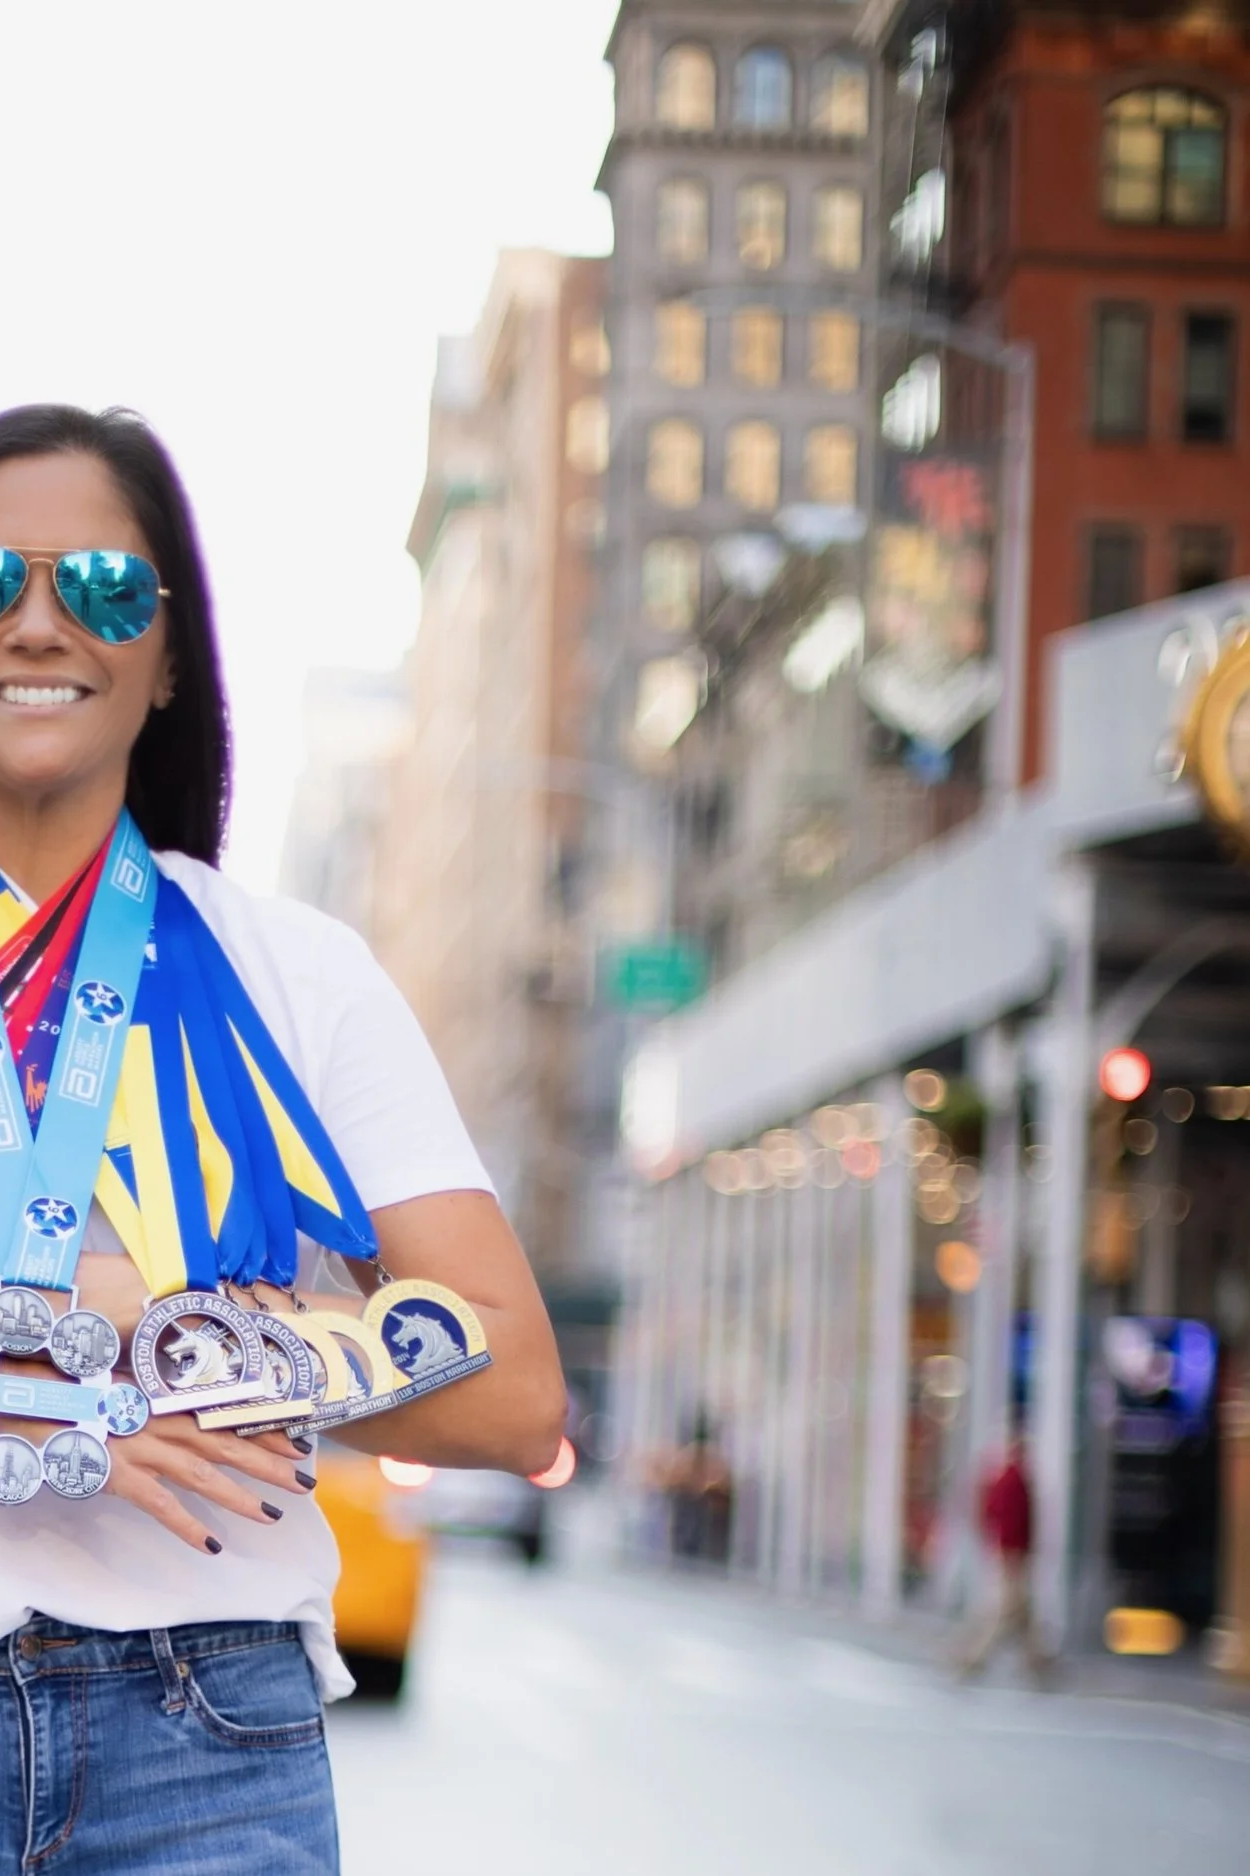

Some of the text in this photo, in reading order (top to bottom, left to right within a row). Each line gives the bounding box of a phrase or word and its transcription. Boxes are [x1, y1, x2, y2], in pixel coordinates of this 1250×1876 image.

[138, 1297, 262, 1391] BOSTON ATHLETIC ASSOCIATION
[255, 1316, 312, 1392] ASSOCIATION
[393, 1353, 410, 1365] 2014
[415, 1373, 447, 1393] BOSTON
[447, 1354, 490, 1378] MARATHON
[126, 1404, 135, 1416] 6
[347, 1395, 393, 1417] ARATHON
